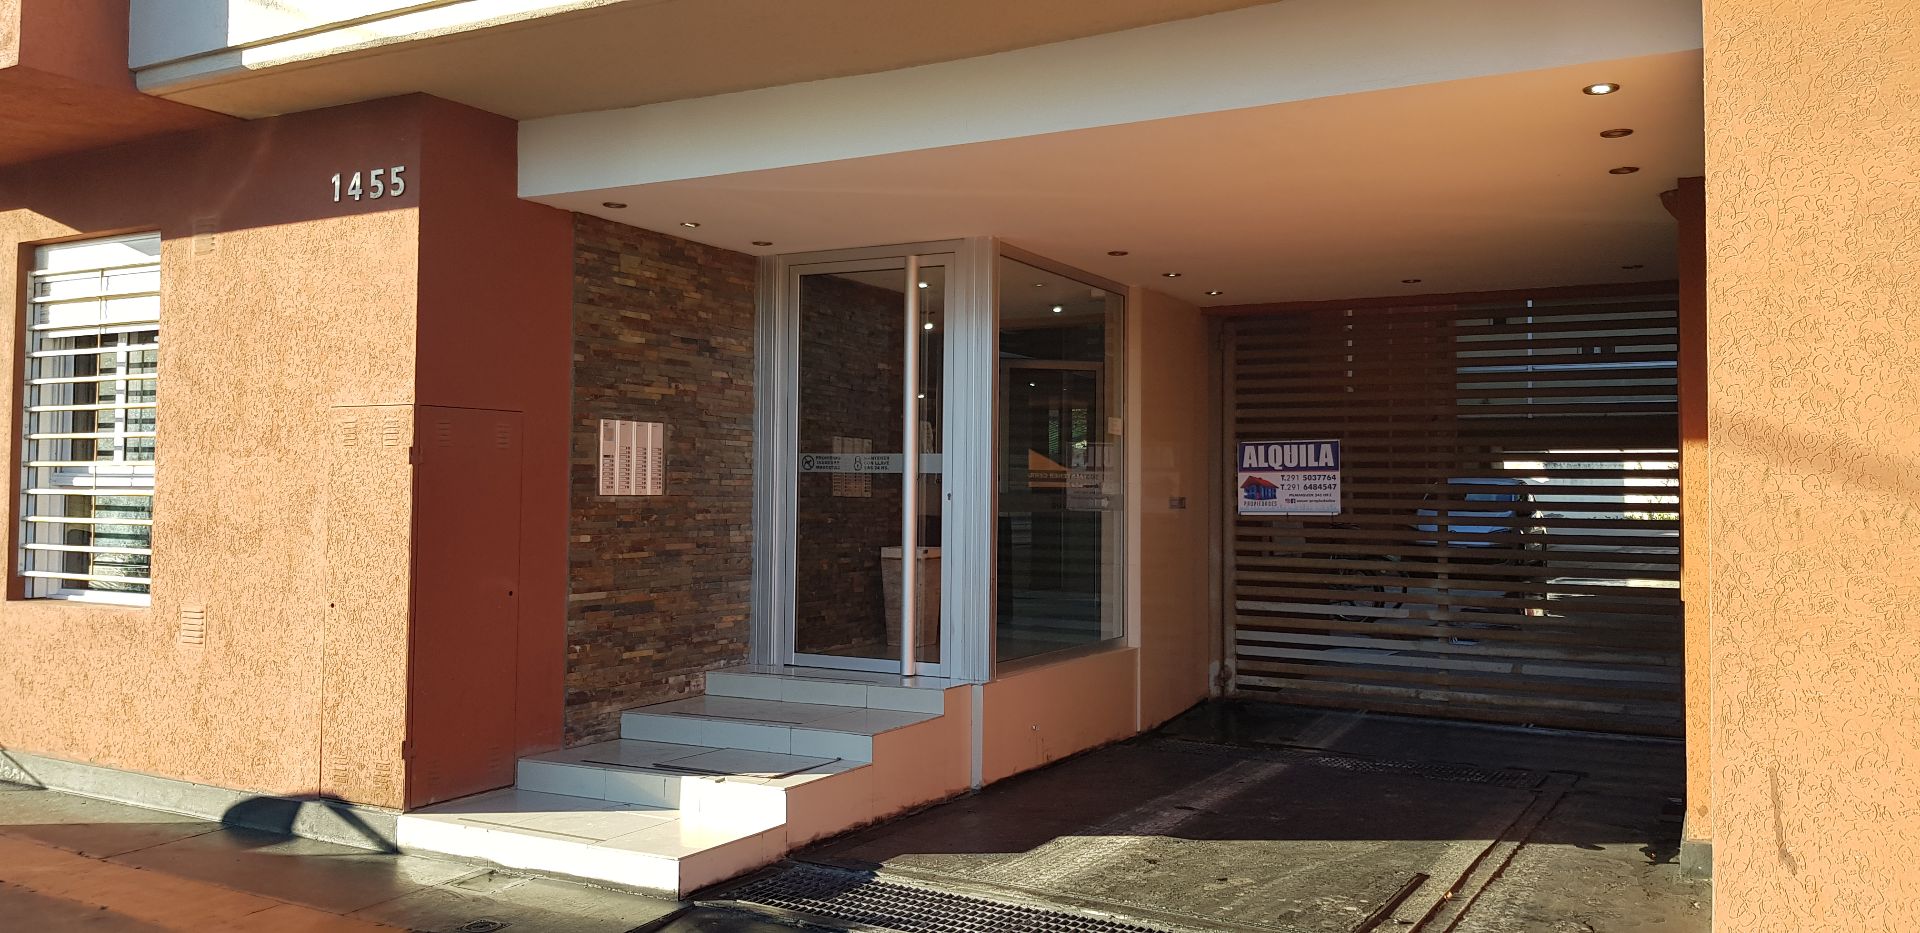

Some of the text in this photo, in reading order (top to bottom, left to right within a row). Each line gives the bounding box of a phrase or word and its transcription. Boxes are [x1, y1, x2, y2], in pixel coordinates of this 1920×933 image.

[331, 166, 405, 202] 1455
[1243, 443, 1334, 470] ALQUILA
[1303, 483, 1337, 491] 6484547
